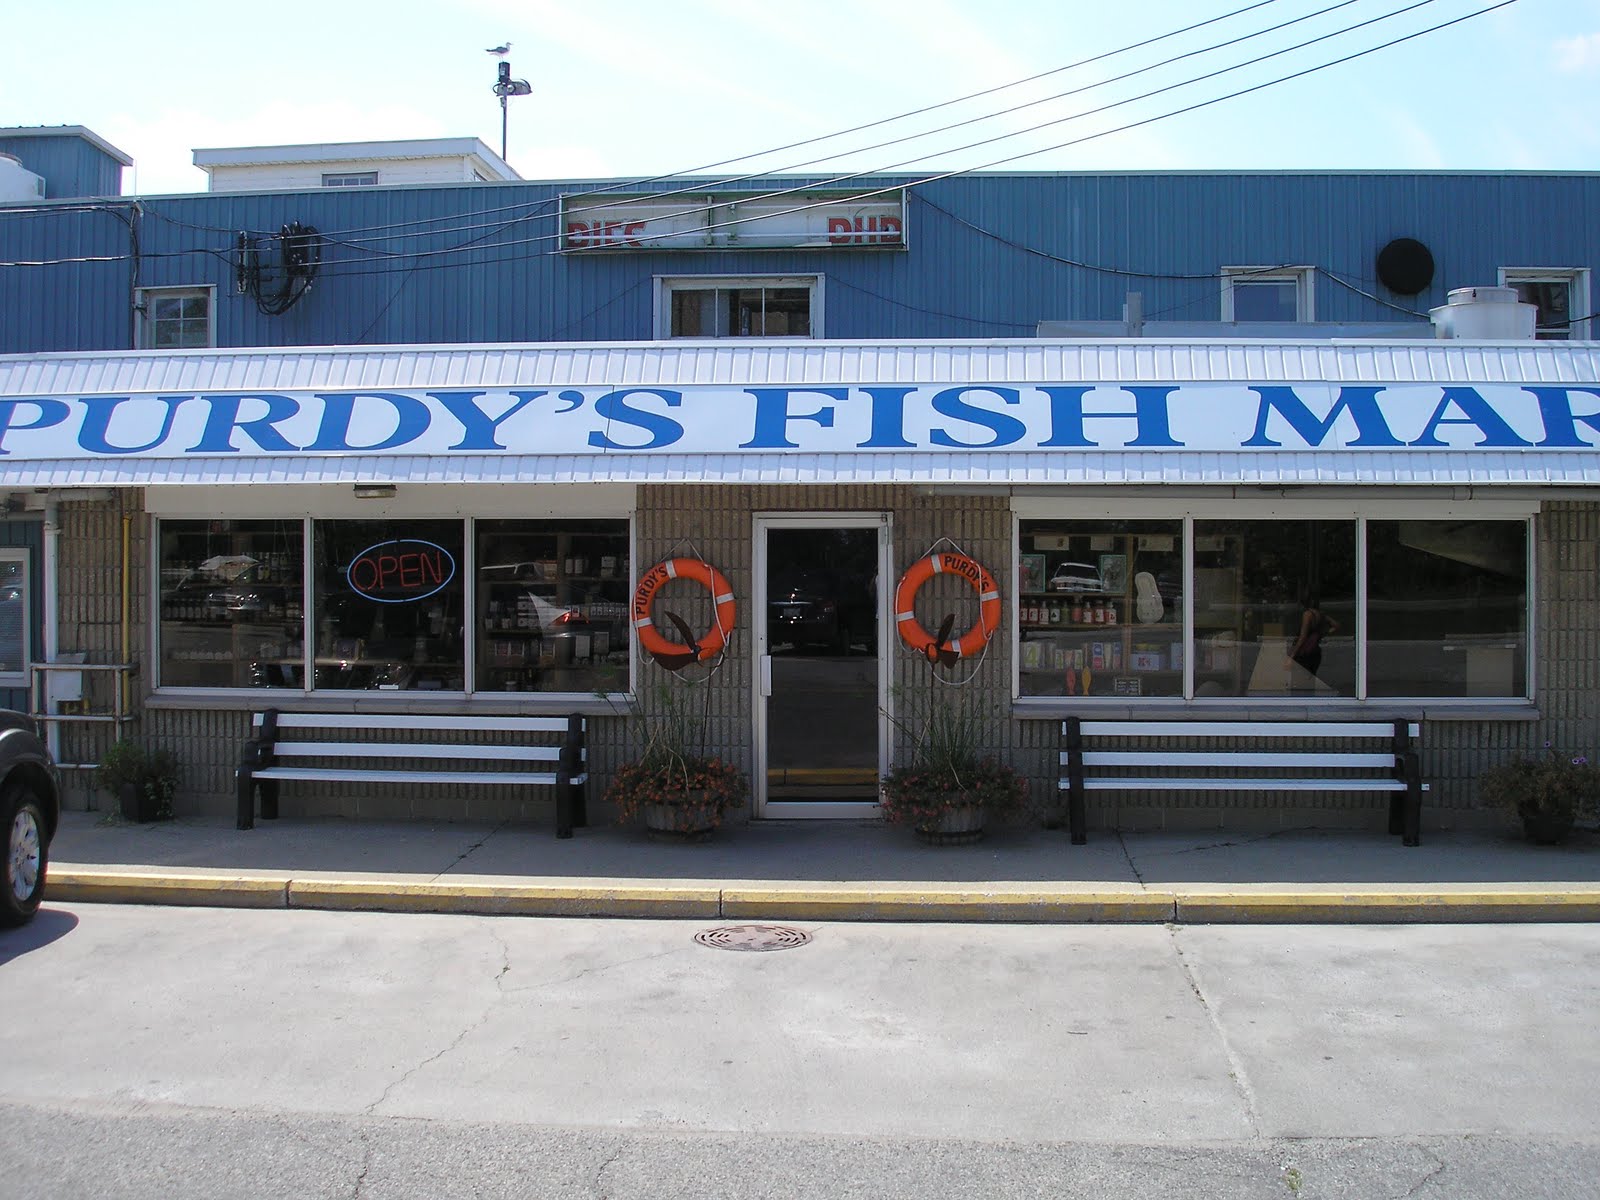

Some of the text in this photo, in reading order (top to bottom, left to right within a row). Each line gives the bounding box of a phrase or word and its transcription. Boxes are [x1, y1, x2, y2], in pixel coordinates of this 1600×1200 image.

[0, 385, 1600, 454] PURDY'S FISH MAR
[352, 551, 443, 591] OPEN
[635, 565, 668, 615] PURDY'S
[944, 555, 990, 591] PURDY'S
